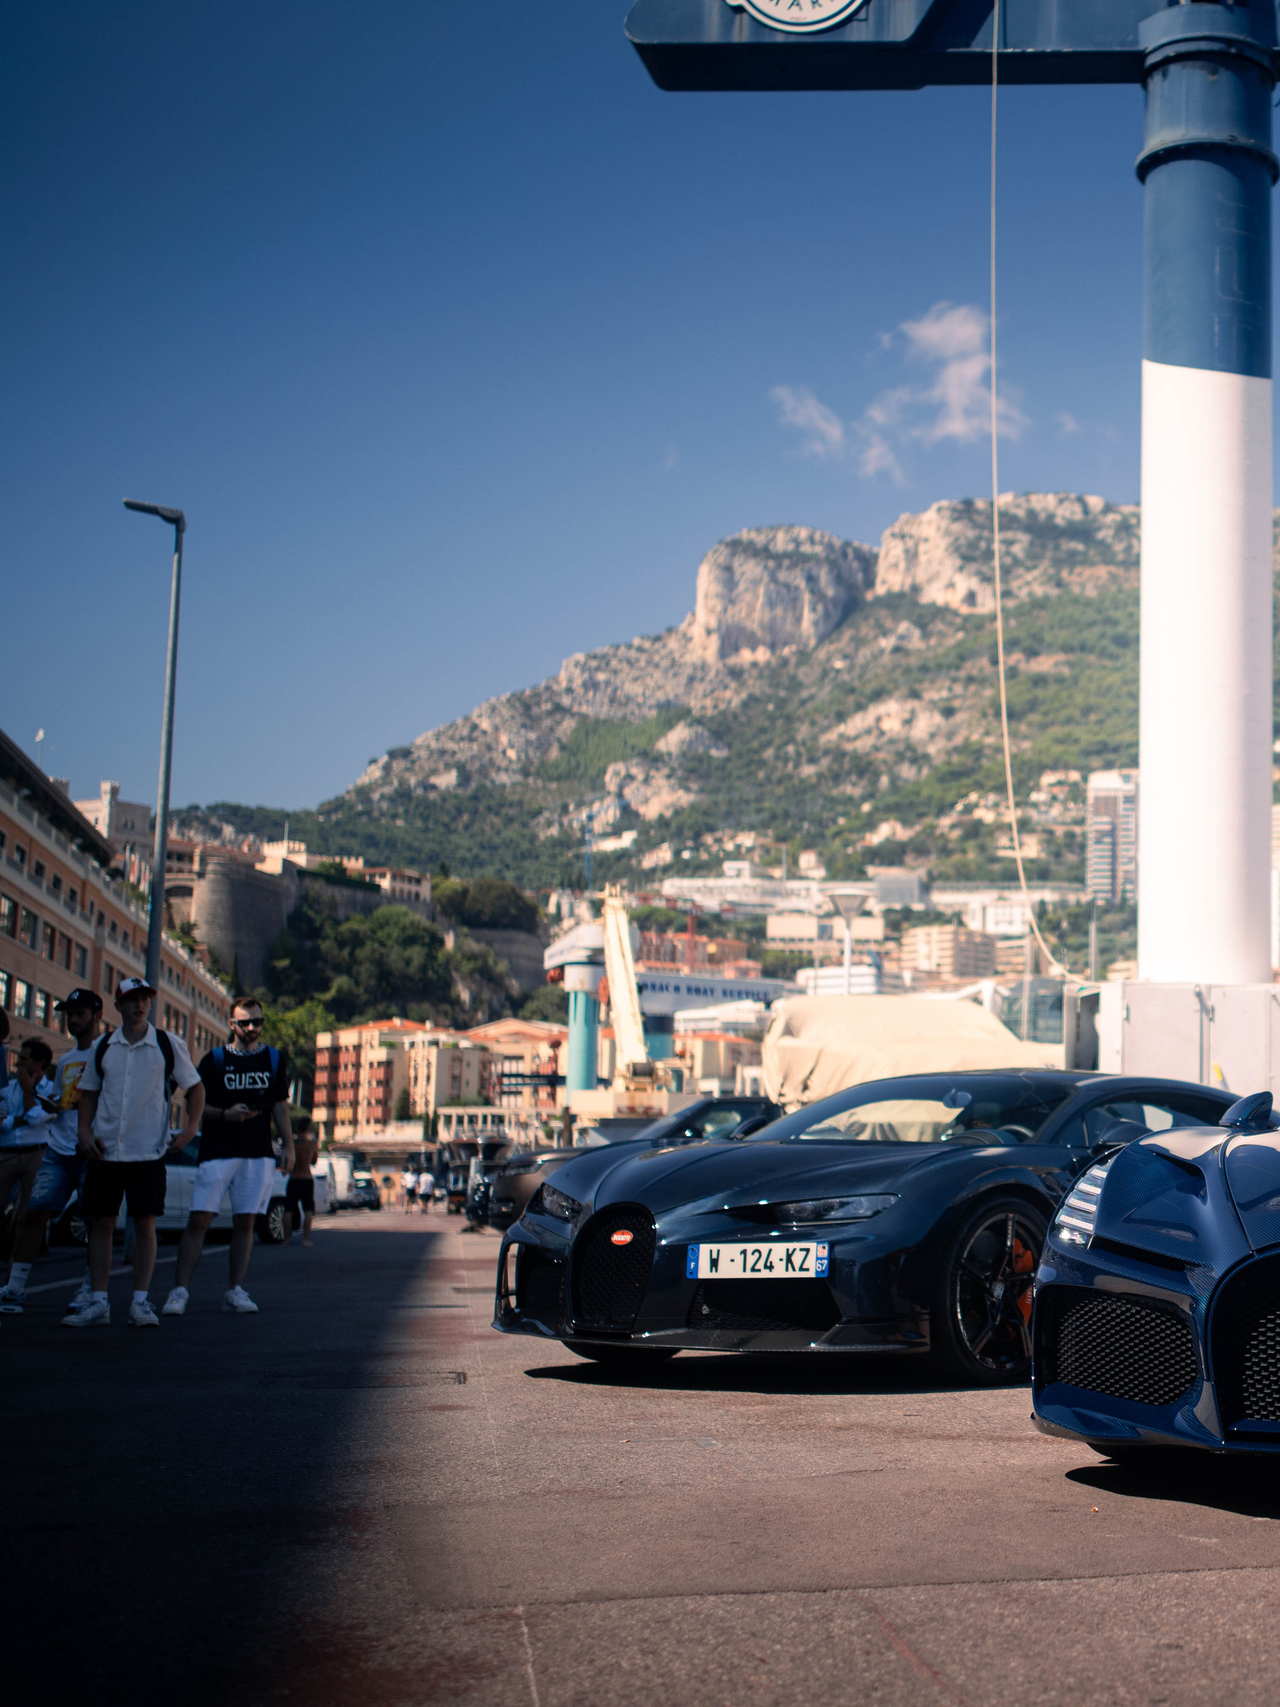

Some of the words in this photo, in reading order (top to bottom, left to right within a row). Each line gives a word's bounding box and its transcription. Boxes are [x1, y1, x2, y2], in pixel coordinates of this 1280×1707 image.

[641, 981, 681, 994] ONACO
[224, 1071, 270, 1090] GUESS
[816, 1260, 828, 1271] 67
